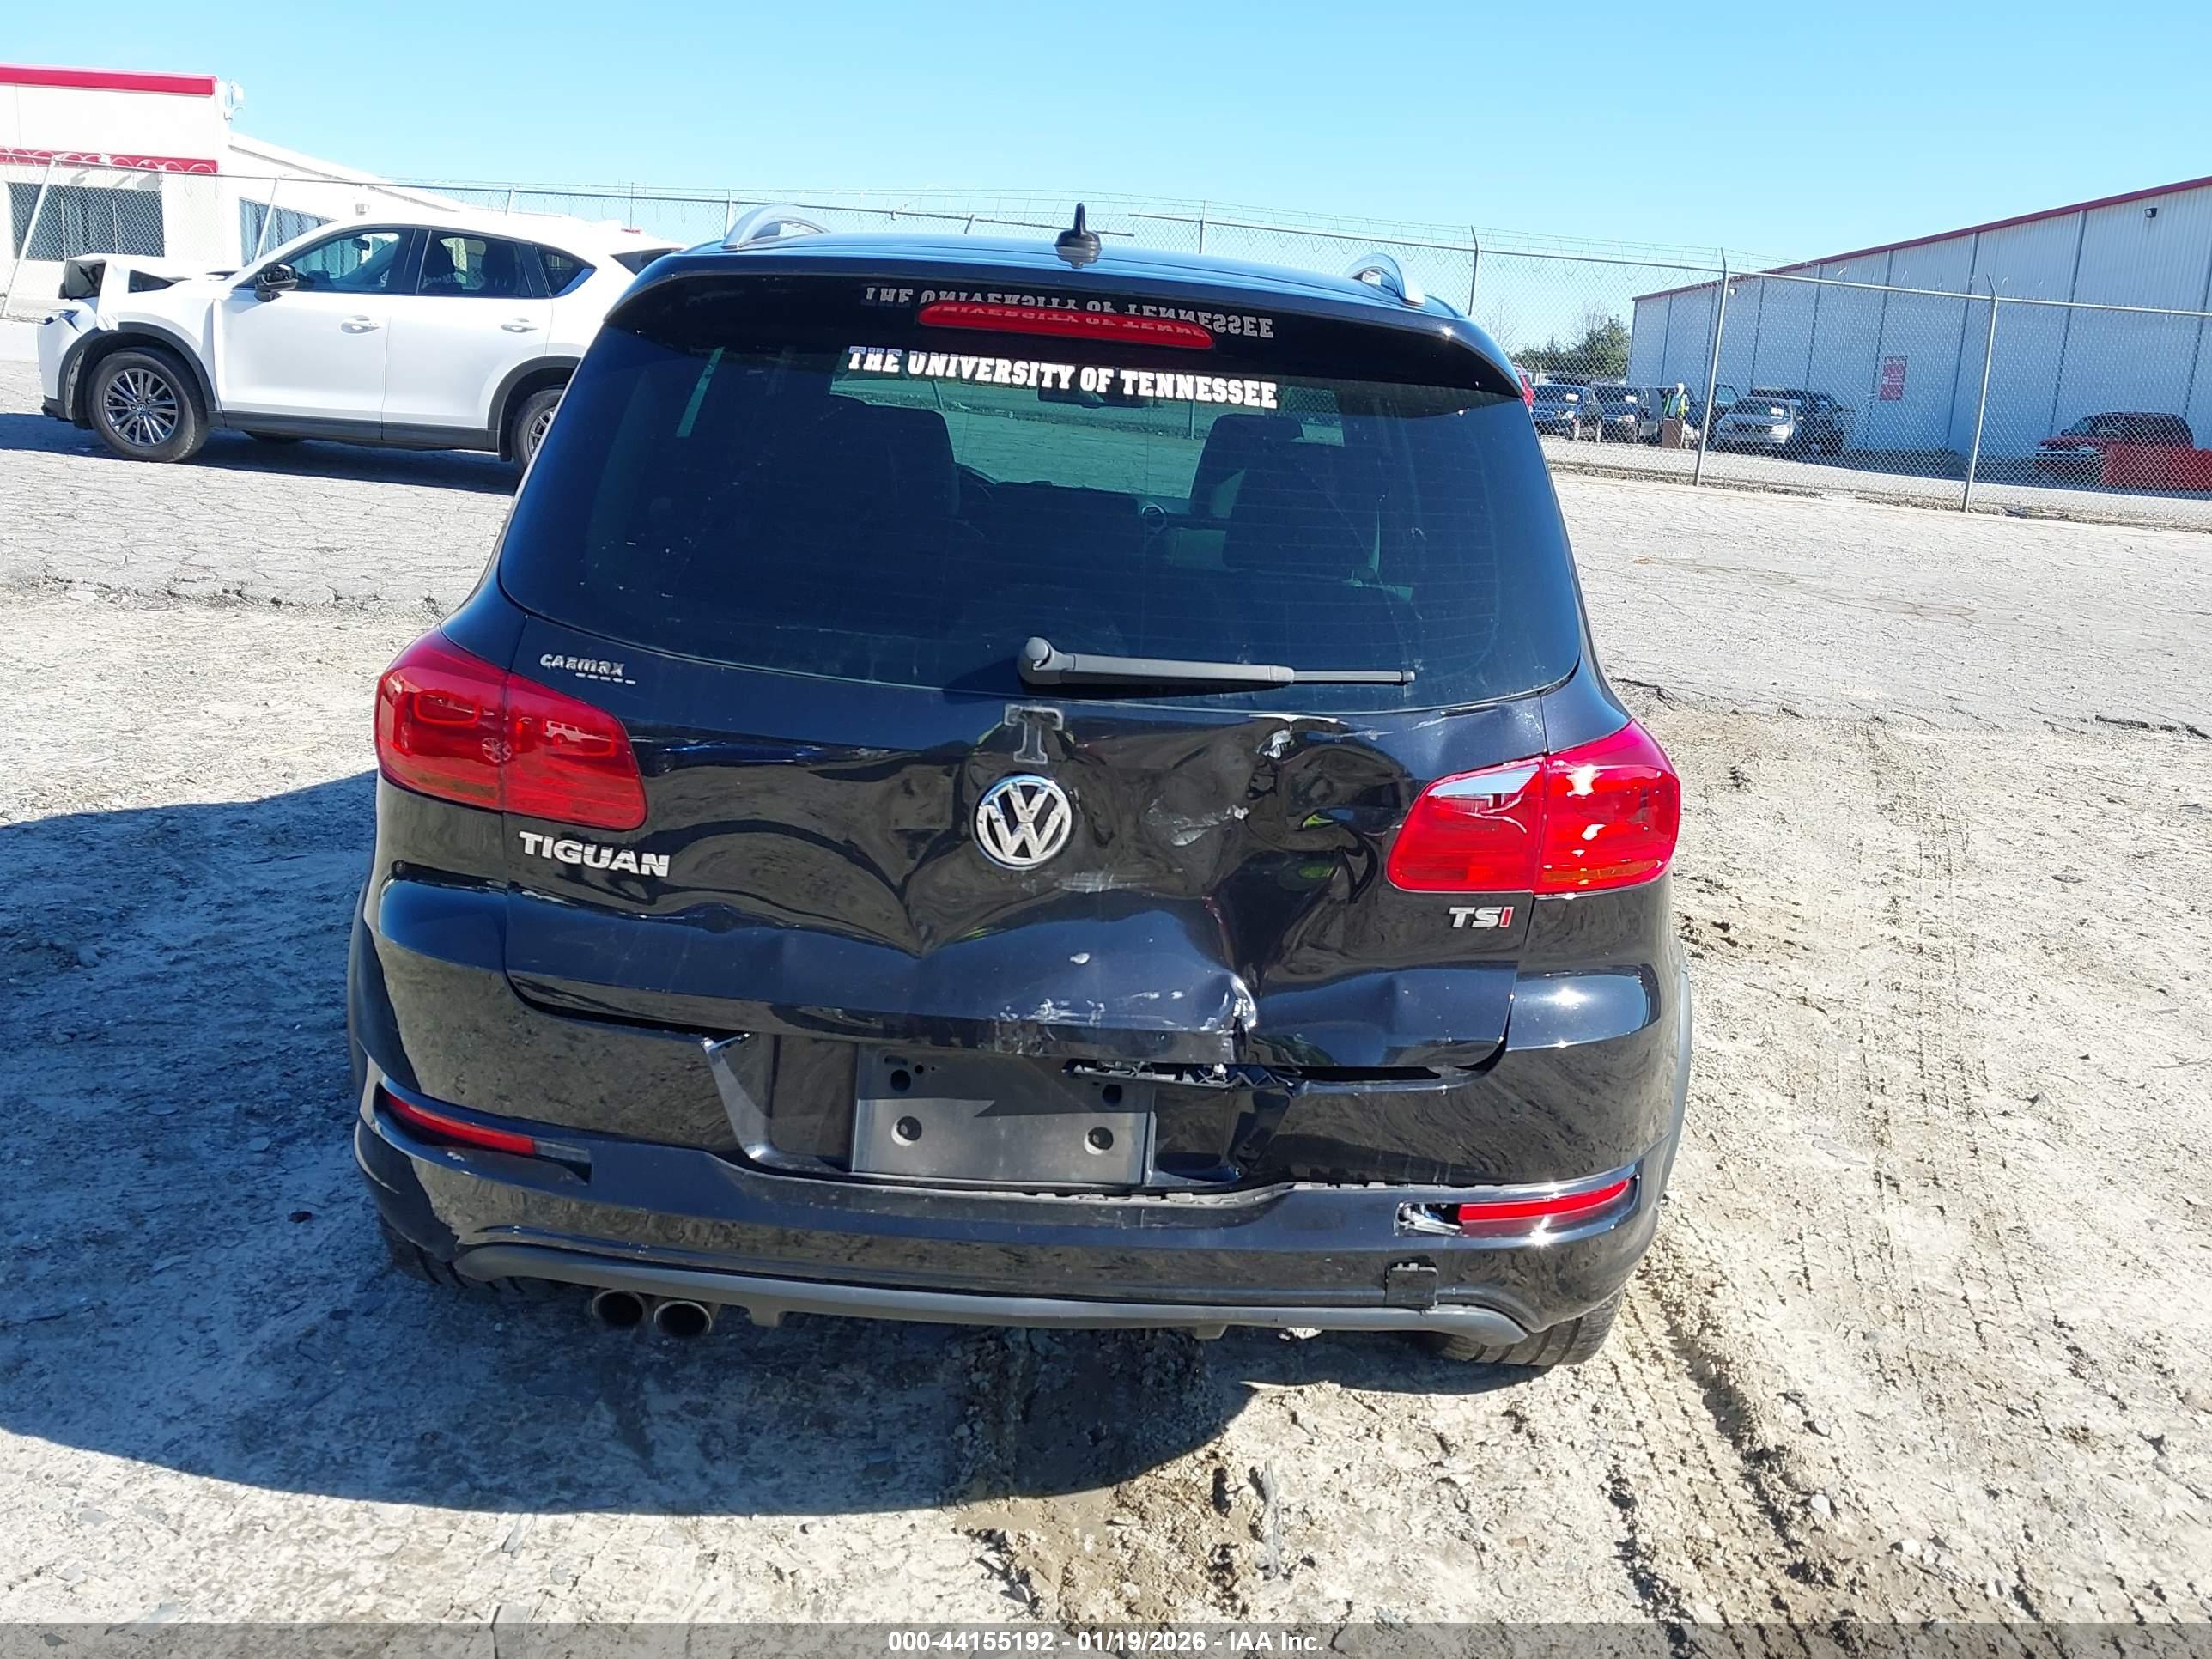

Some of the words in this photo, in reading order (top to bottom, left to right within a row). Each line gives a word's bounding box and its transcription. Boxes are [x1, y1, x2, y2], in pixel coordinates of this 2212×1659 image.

[848, 346, 902, 374] THE
[908, 350, 1076, 390] UNIVERSITY
[1079, 367, 1114, 393] OF
[1119, 369, 1278, 410] TENNESSEE
[1004, 703, 1064, 765] T
[518, 830, 671, 878] TIGUAN
[1449, 906, 1515, 928] TSI
